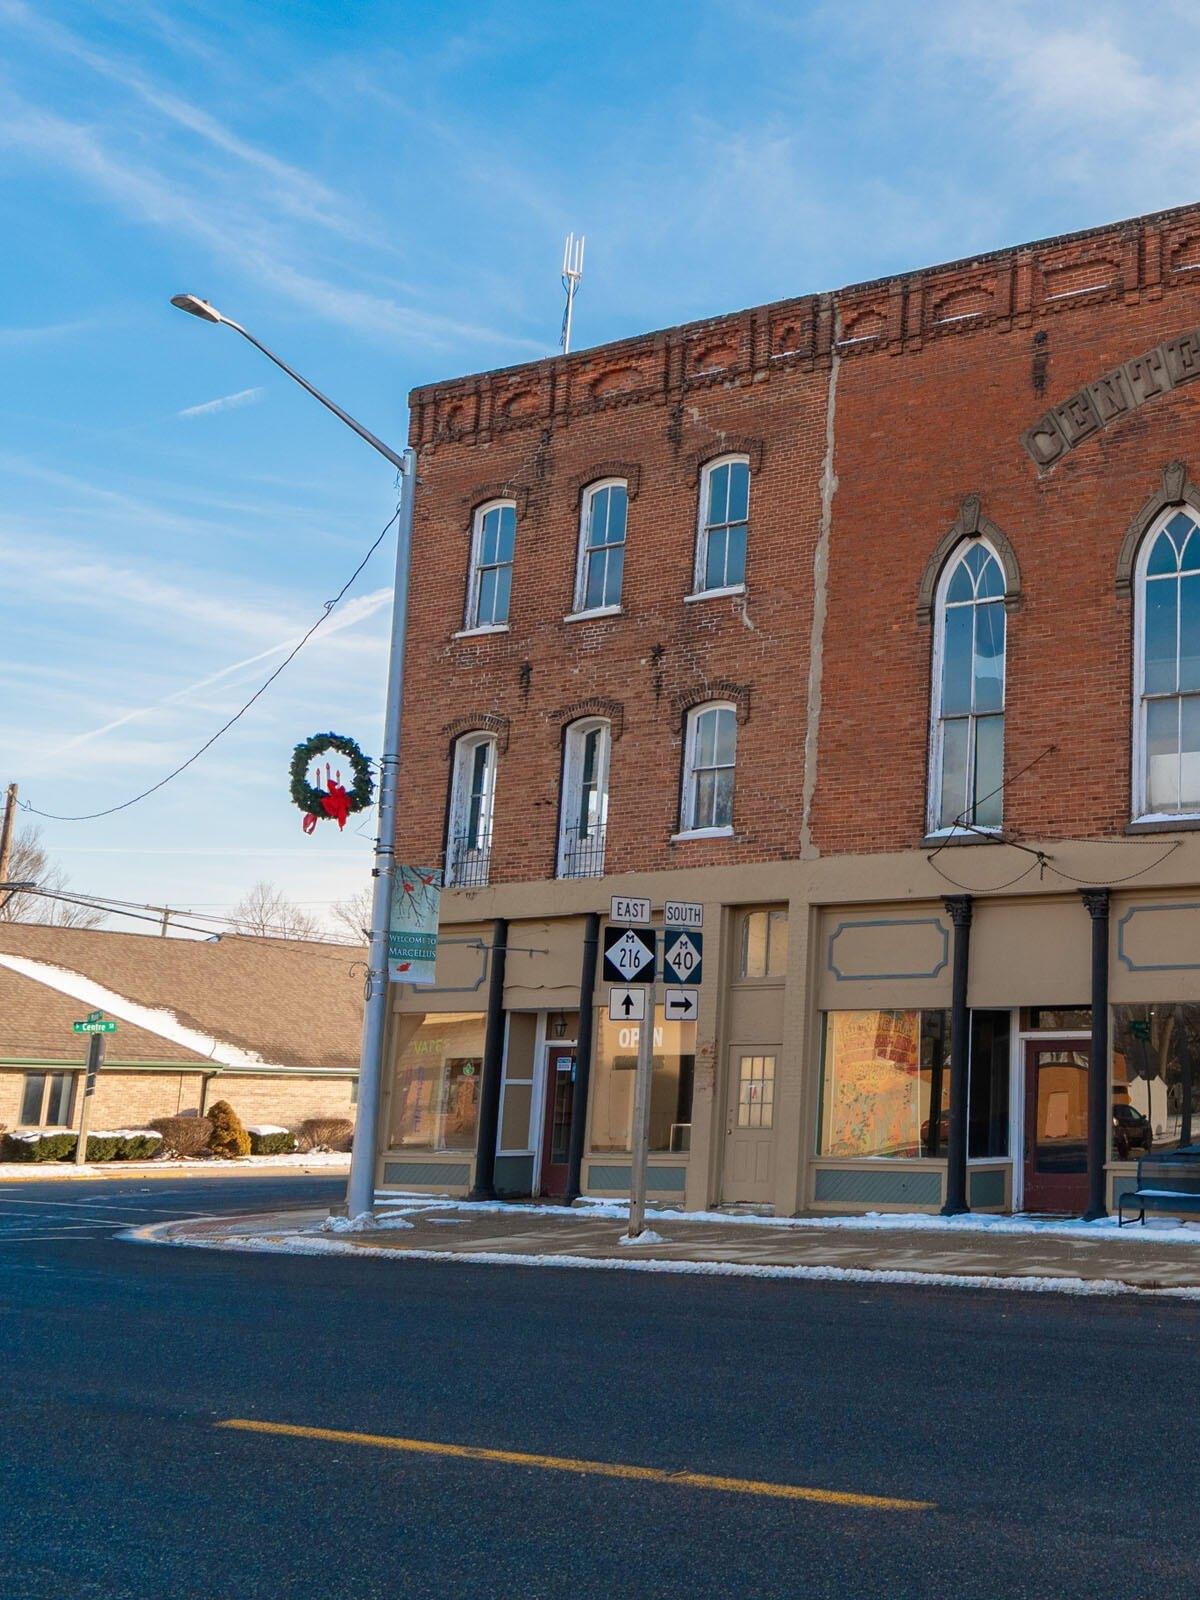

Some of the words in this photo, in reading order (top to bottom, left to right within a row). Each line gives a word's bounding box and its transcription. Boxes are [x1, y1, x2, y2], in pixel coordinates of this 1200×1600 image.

[616, 902, 646, 919] EAST
[666, 906, 701, 923] SOUTH
[625, 934, 635, 943] M
[679, 940, 689, 950] M
[389, 946, 437, 958] MARCELLUS
[618, 947, 641, 970] 216
[672, 951, 694, 971] 40
[82, 1022, 106, 1031] Centre
[619, 1028, 663, 1048] OPN
